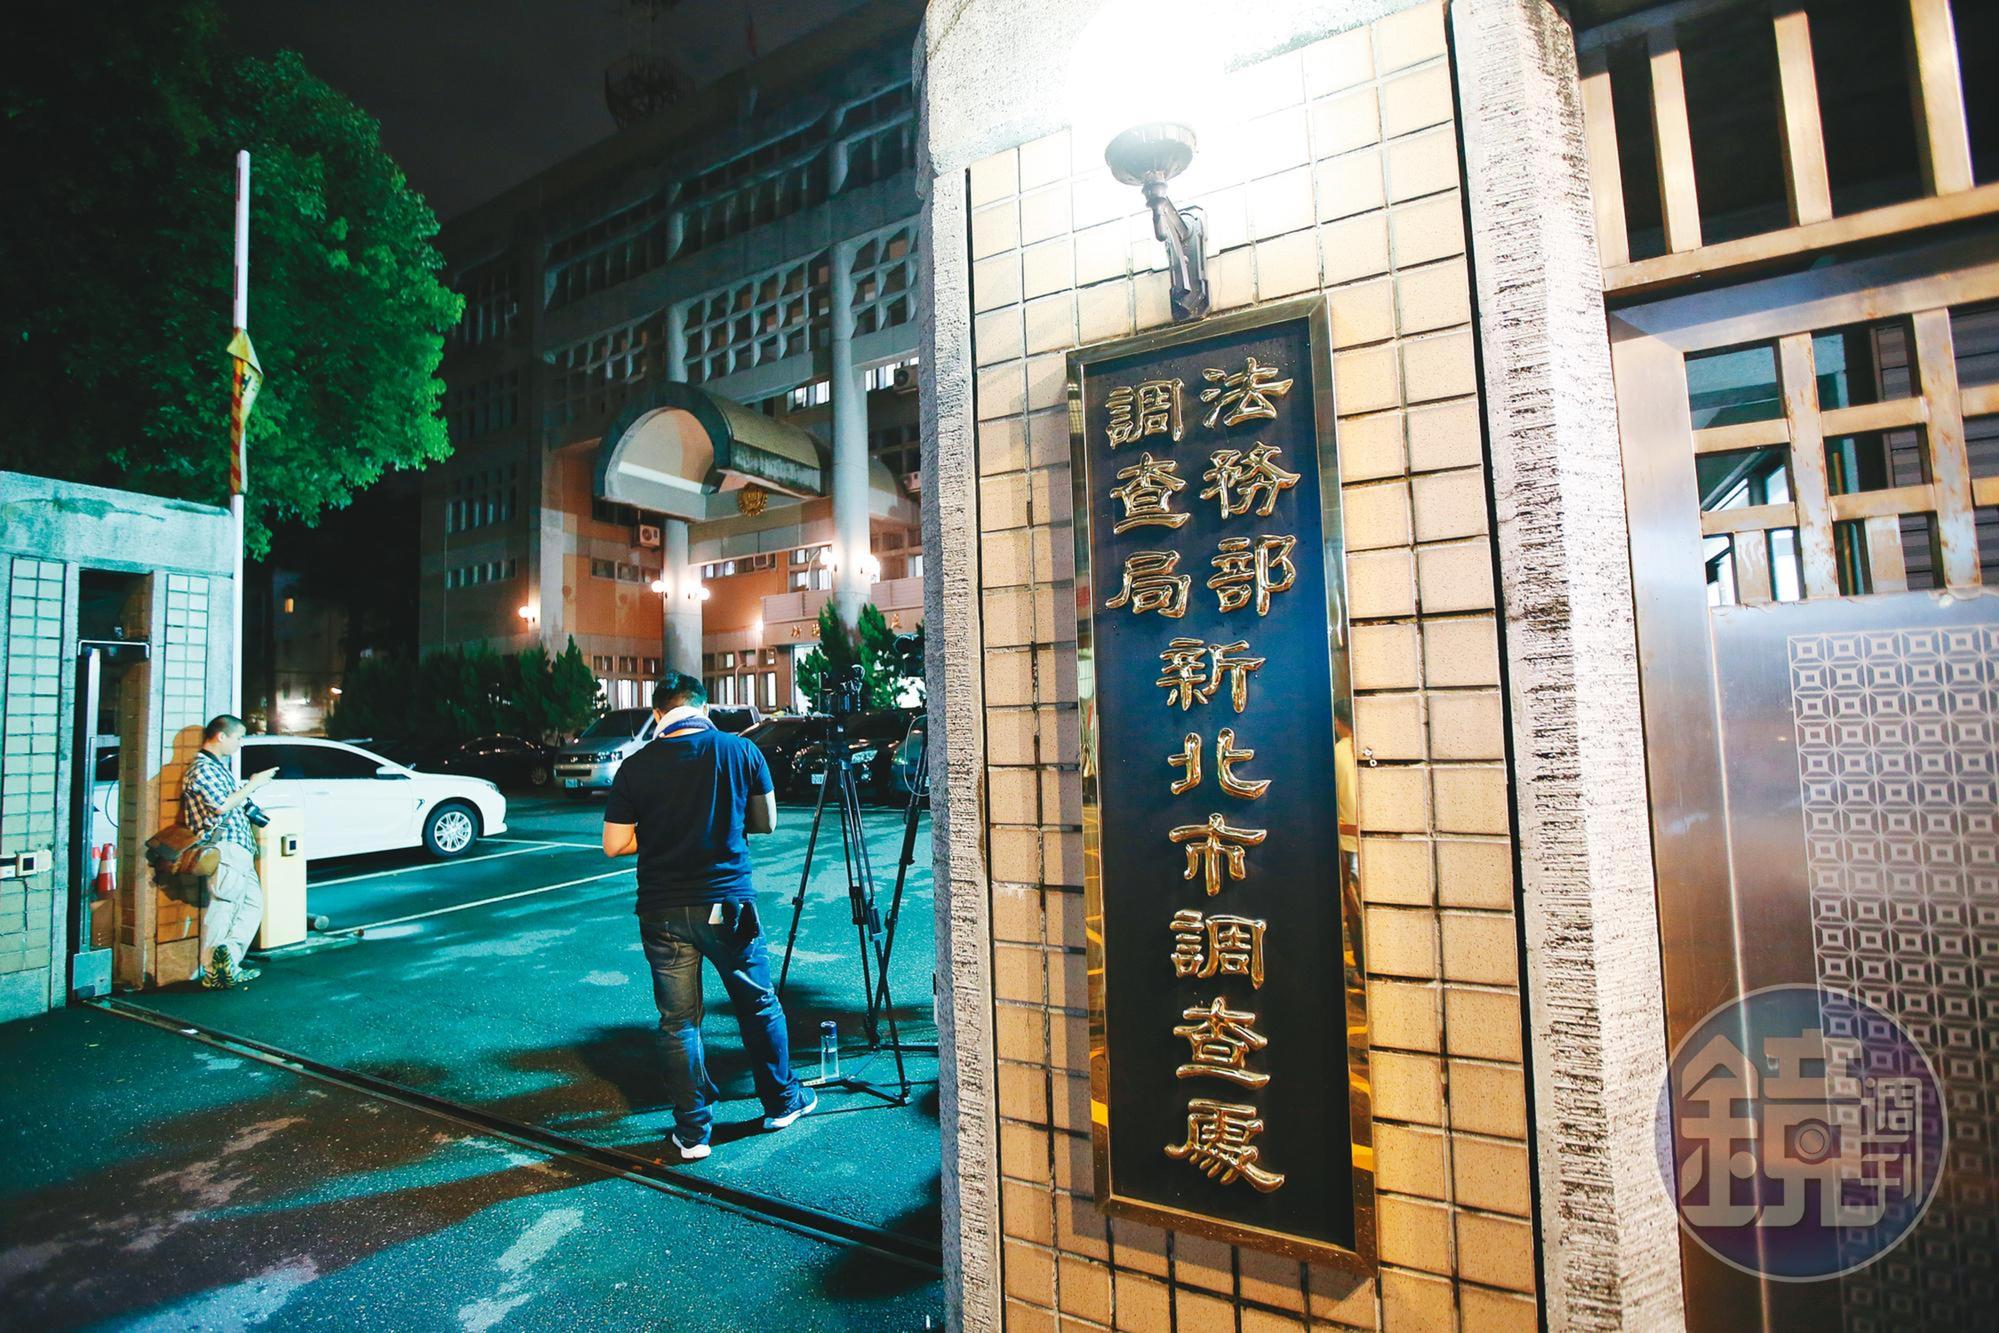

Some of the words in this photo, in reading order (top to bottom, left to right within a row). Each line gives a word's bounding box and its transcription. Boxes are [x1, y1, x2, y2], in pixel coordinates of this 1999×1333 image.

[1105, 379, 1191, 618] 調查局
[1200, 357, 1301, 616] 法務部
